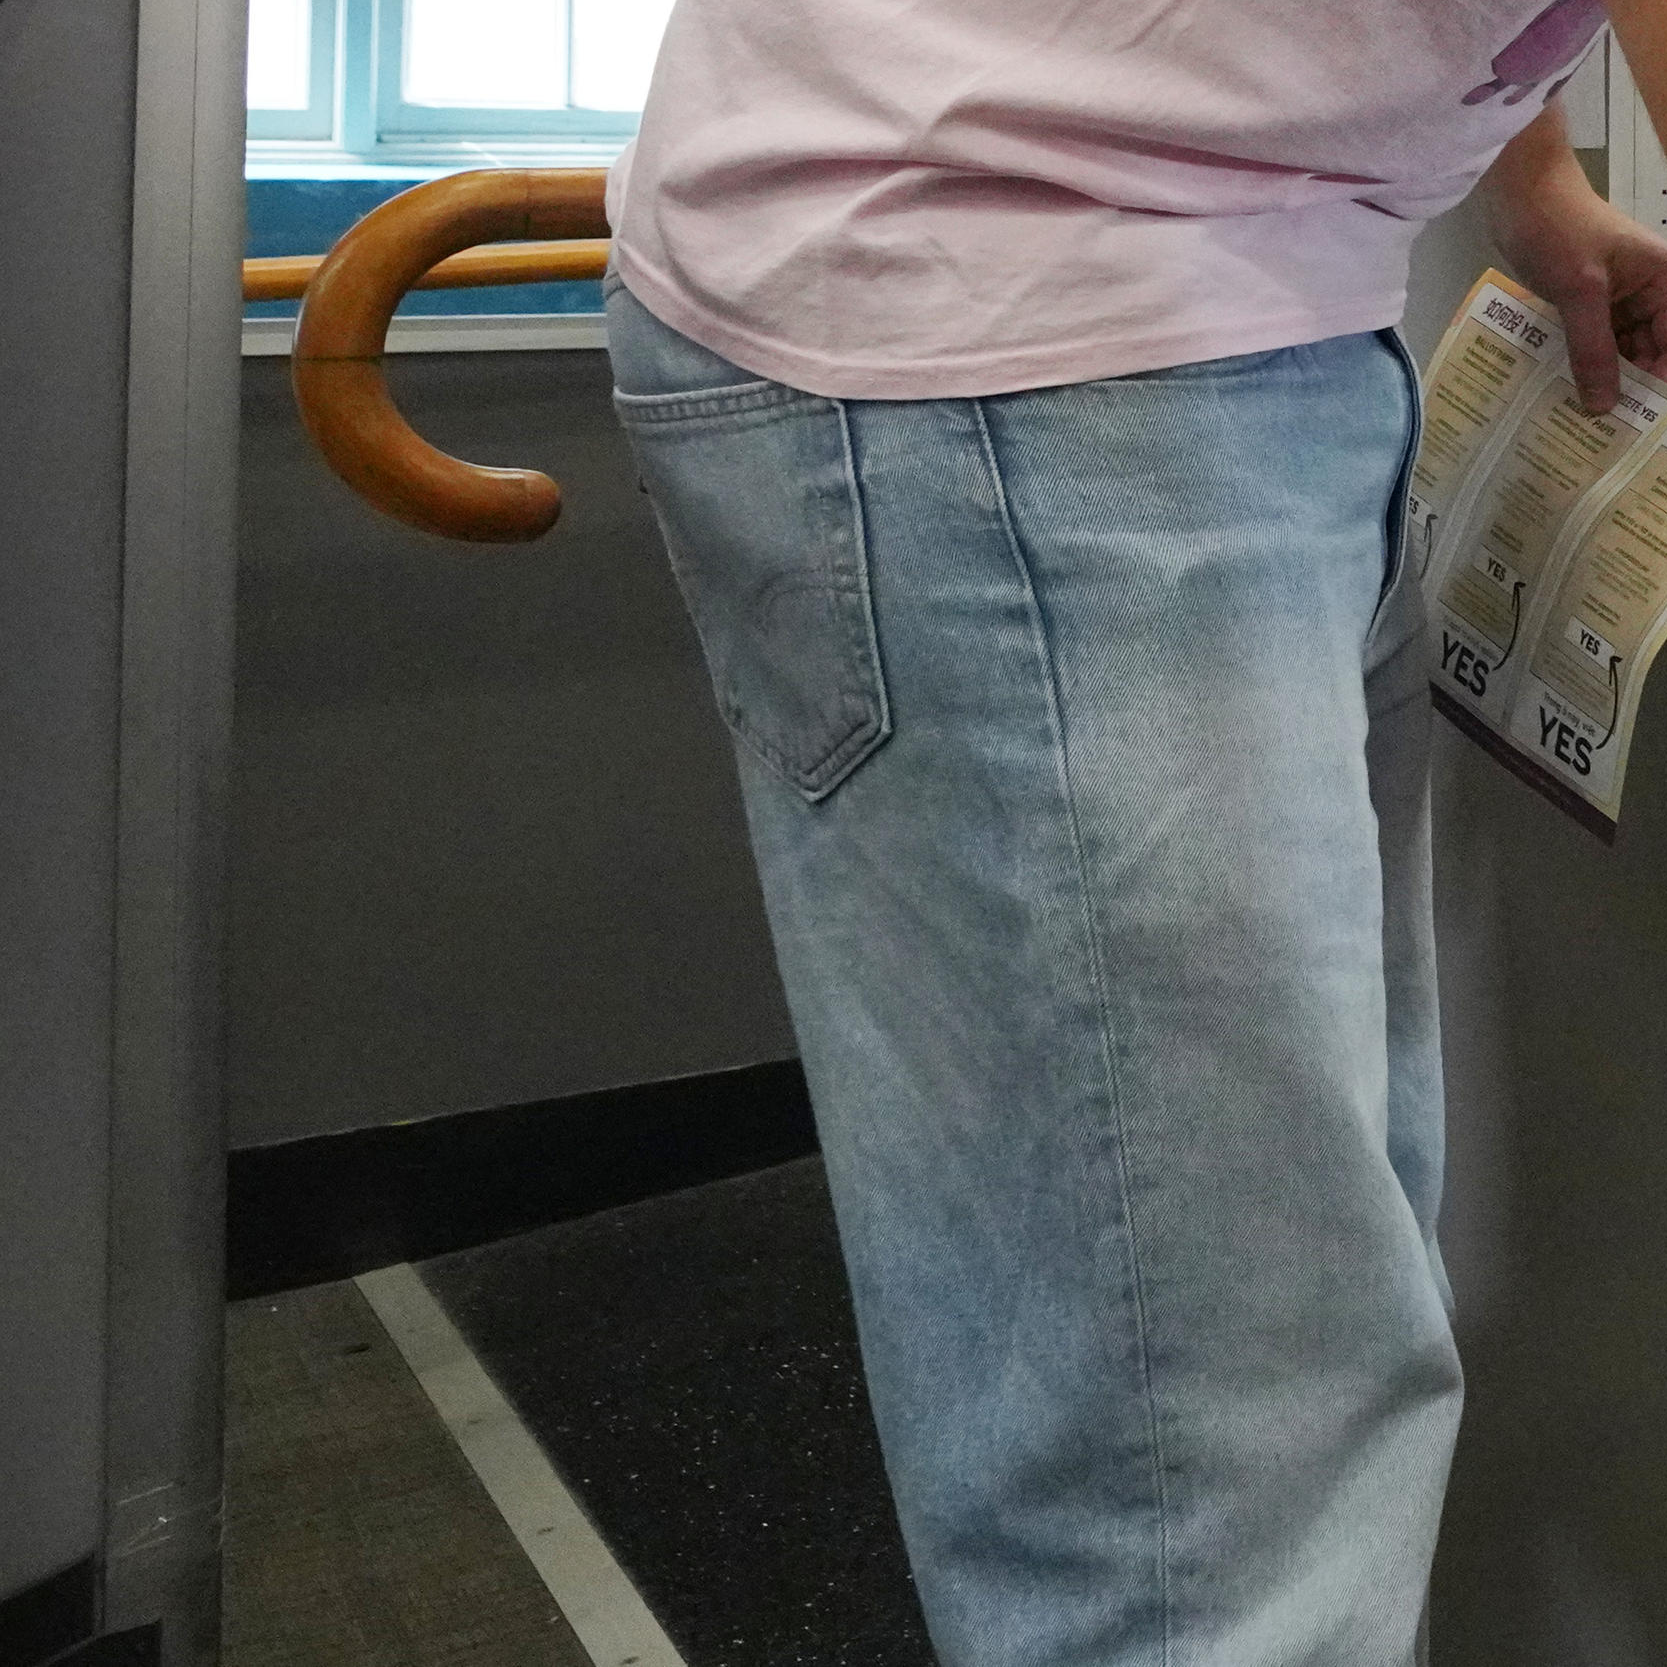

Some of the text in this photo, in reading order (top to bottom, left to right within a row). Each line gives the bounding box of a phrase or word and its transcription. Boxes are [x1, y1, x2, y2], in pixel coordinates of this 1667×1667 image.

[1519, 322, 1548, 348] YES
[1640, 406, 1659, 423] YES
[1487, 557, 1506, 582] YES
[1579, 629, 1600, 656] YES
[1441, 631, 1491, 698] YES
[1538, 705, 1594, 776] YES
